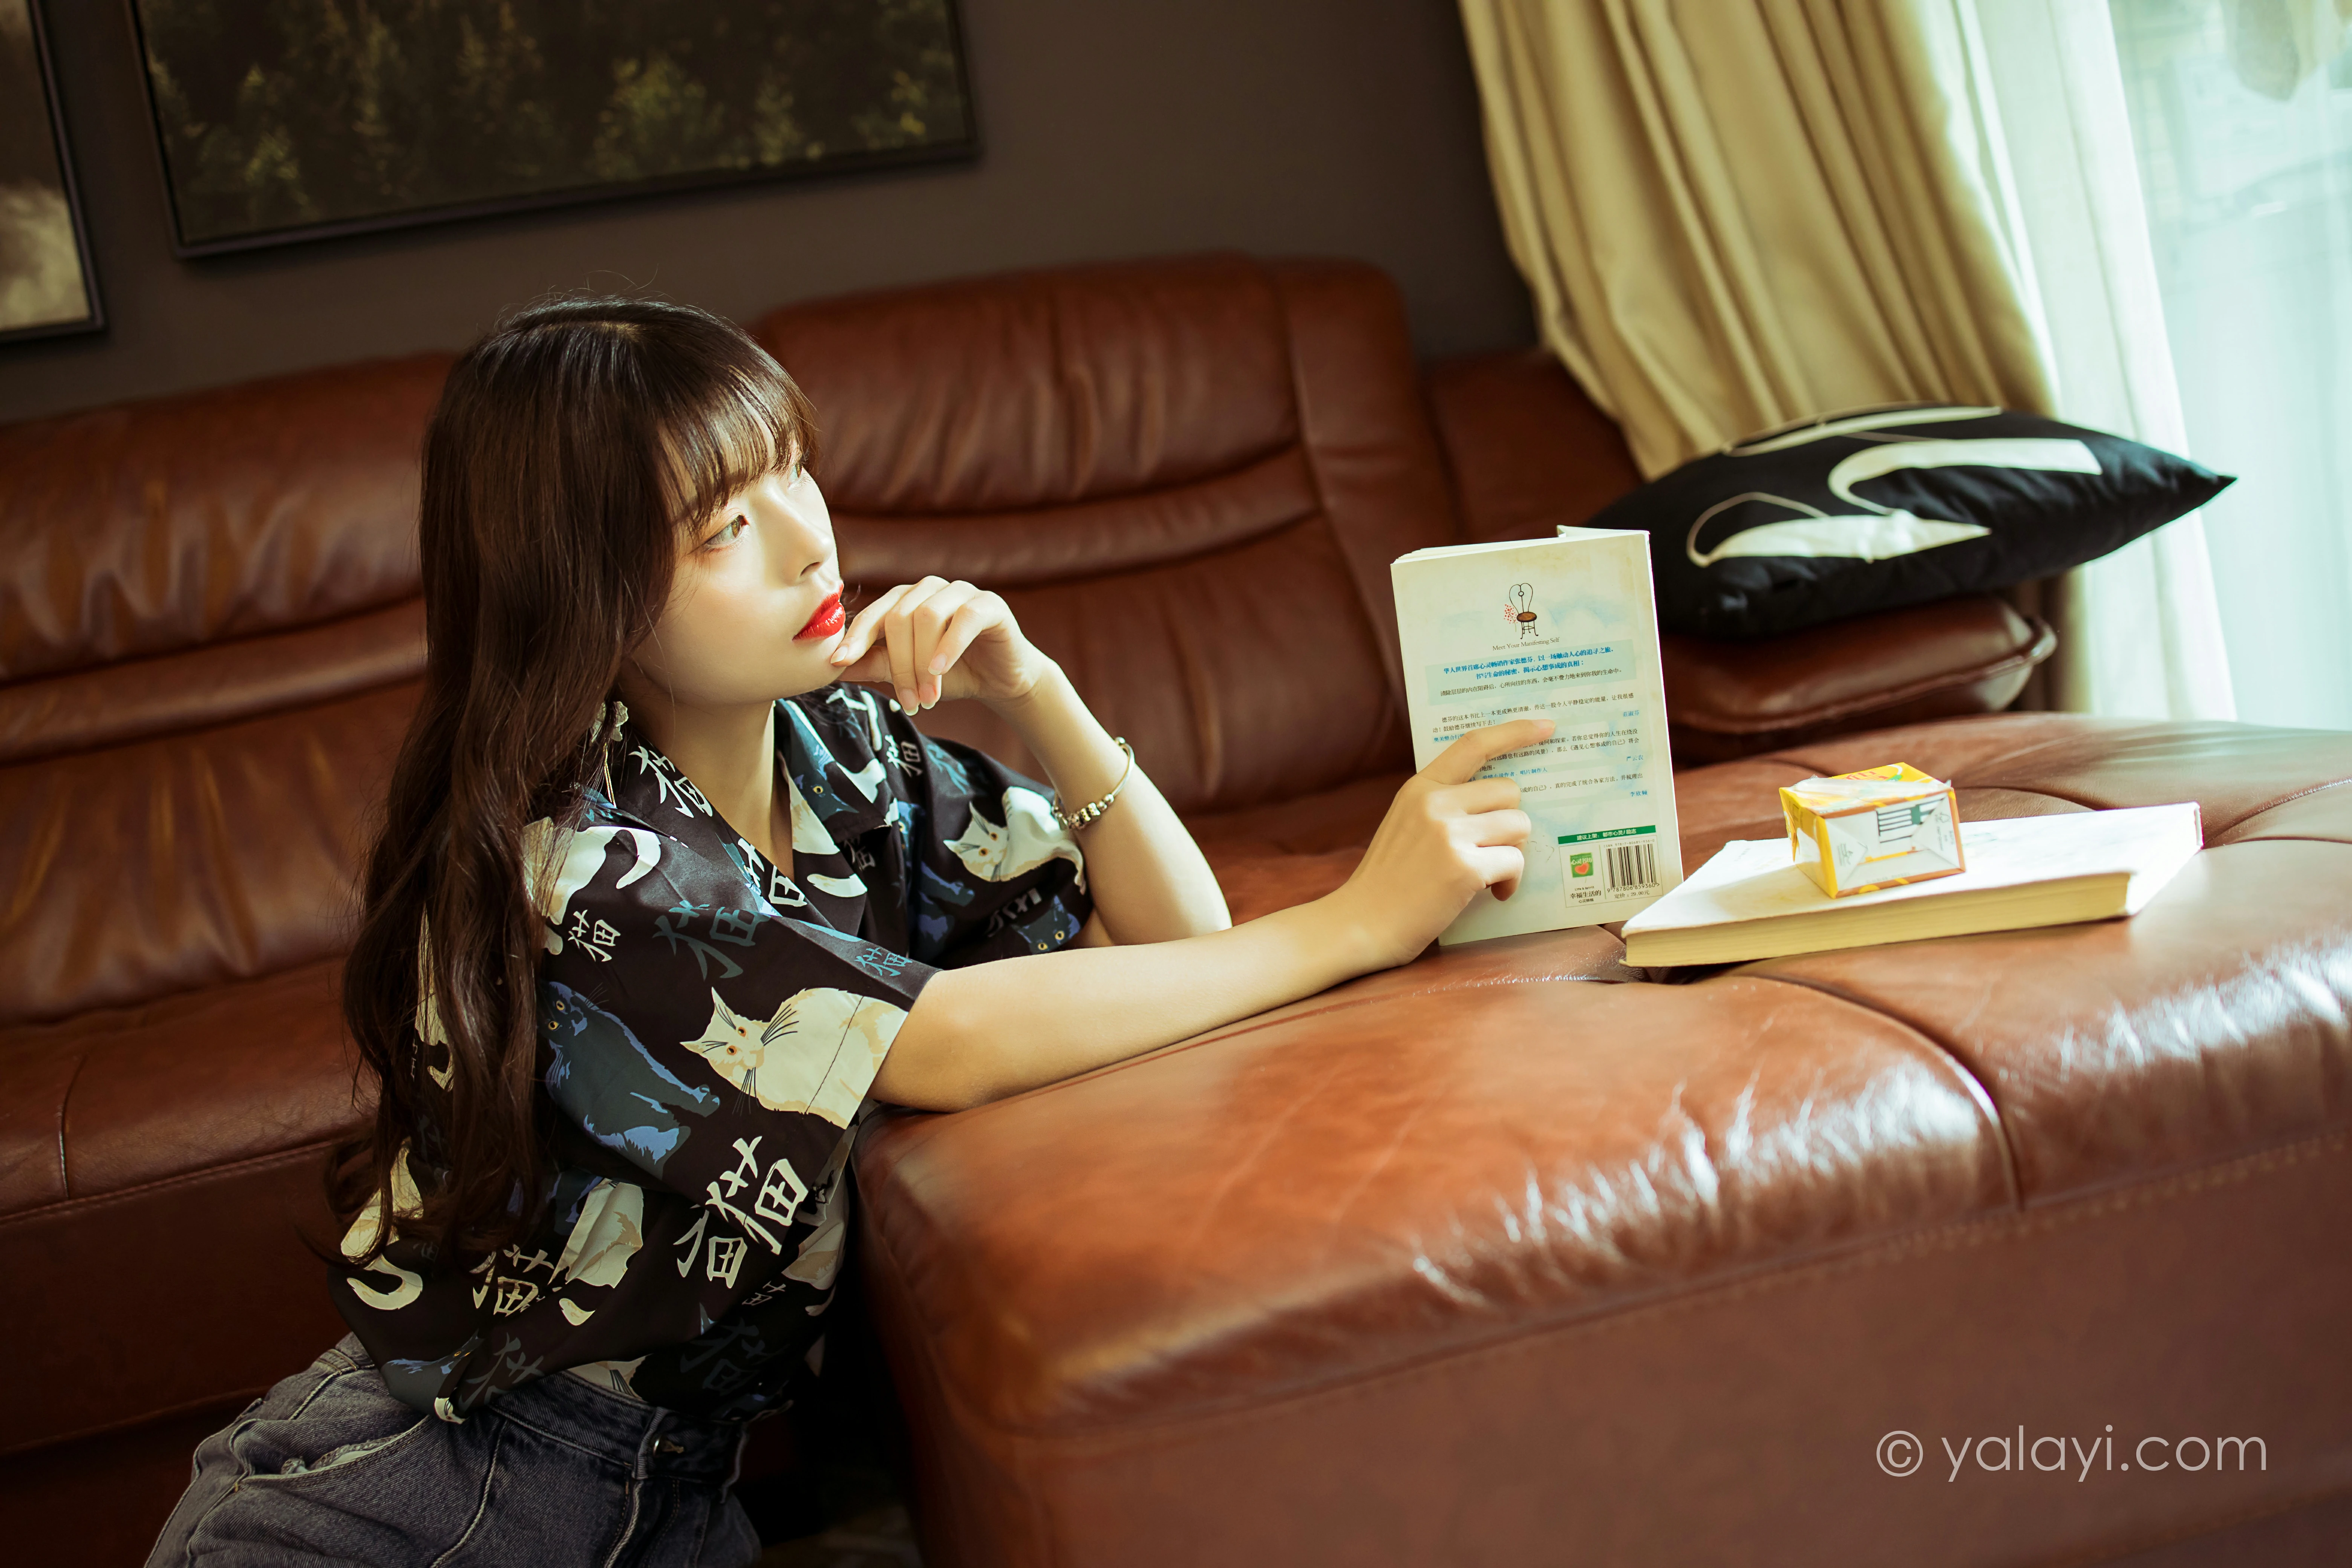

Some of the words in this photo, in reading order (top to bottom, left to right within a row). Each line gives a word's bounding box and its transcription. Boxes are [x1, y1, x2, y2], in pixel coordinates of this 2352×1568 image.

[628, 746, 713, 818] 猫
[885, 734, 923, 778] 猫
[1570, 890, 1601, 899] 幸福生活的
[568, 910, 621, 962] 猫
[652, 900, 771, 981] 猫
[855, 947, 913, 977] 猫
[705, 1135, 808, 1256] 猫
